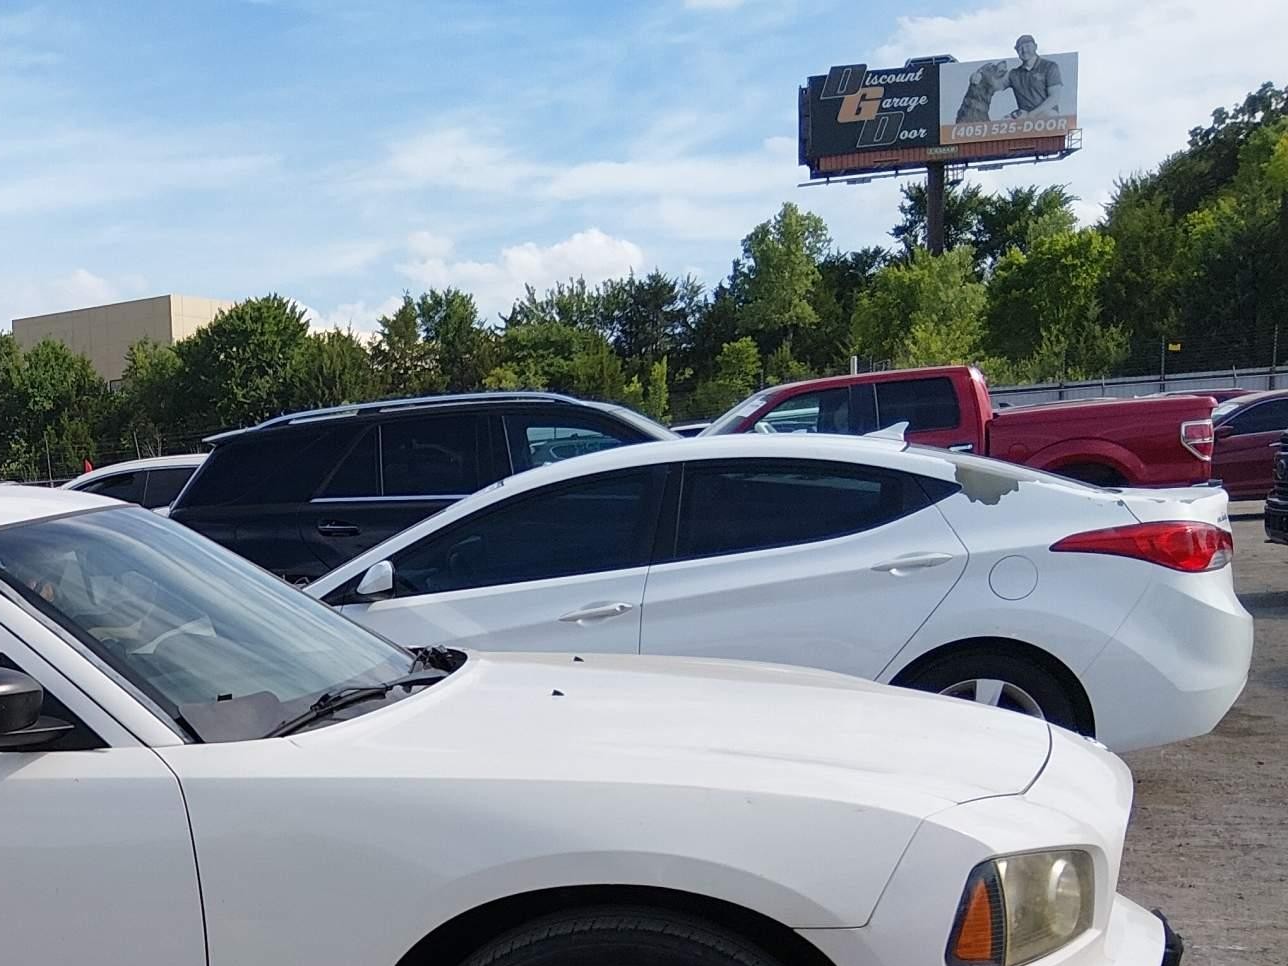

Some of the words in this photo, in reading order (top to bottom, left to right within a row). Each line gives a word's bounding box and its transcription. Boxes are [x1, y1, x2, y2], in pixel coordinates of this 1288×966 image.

[820, 64, 924, 100] Discount
[837, 86, 928, 123] Garage
[856, 111, 927, 148] Door
[952, 124, 987, 139] (405)
[992, 119, 1067, 134] 525-DOOR
